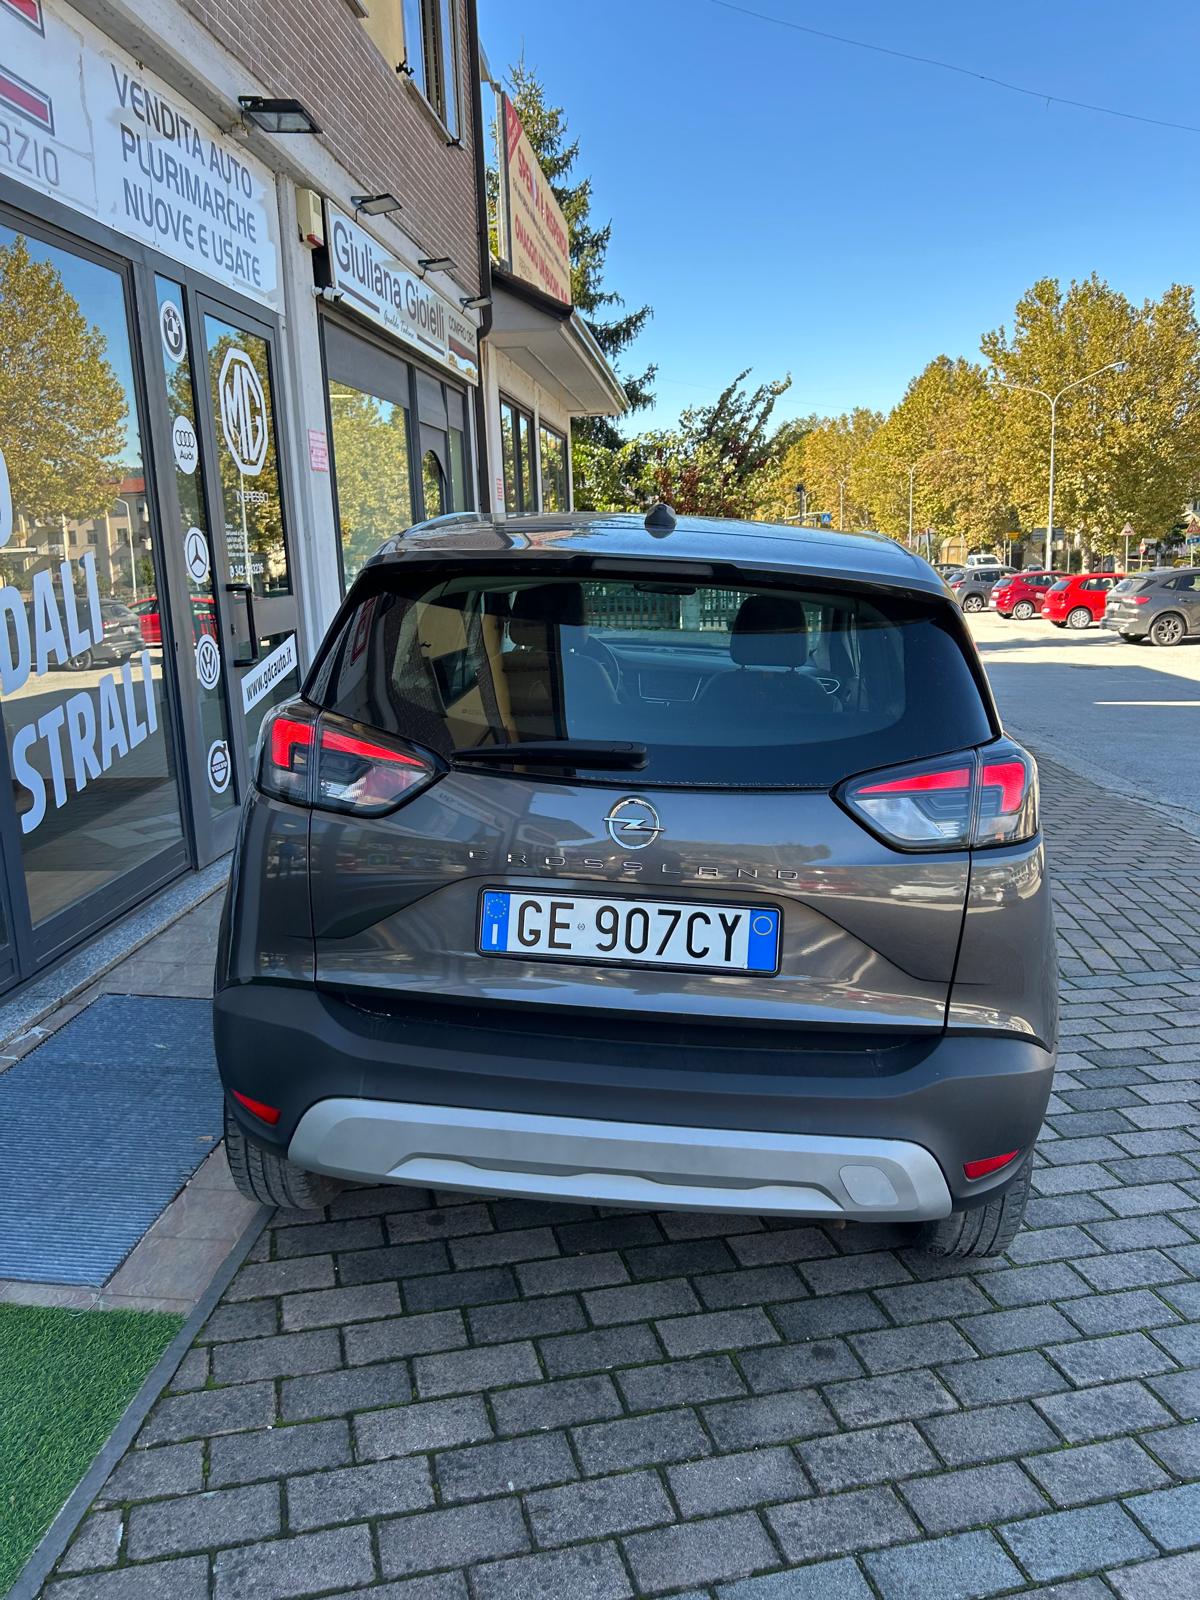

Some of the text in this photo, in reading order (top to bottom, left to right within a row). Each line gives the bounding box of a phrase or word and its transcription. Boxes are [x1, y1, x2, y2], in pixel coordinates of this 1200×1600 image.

[111, 63, 252, 199] VENDITA AUTO
[120, 122, 257, 244] PLURIMARCHE
[123, 177, 262, 287] NUOVE E USATE
[333, 220, 445, 342] Giuliana Gioielli
[179, 450, 195, 461] Audi
[224, 363, 265, 463] MG
[245, 646, 293, 702] www.gdcauto.it
[12, 650, 158, 834] STRALI
[468, 850, 798, 880] CROSSLAND
[517, 900, 574, 949] GE
[595, 905, 743, 962] 907CY
